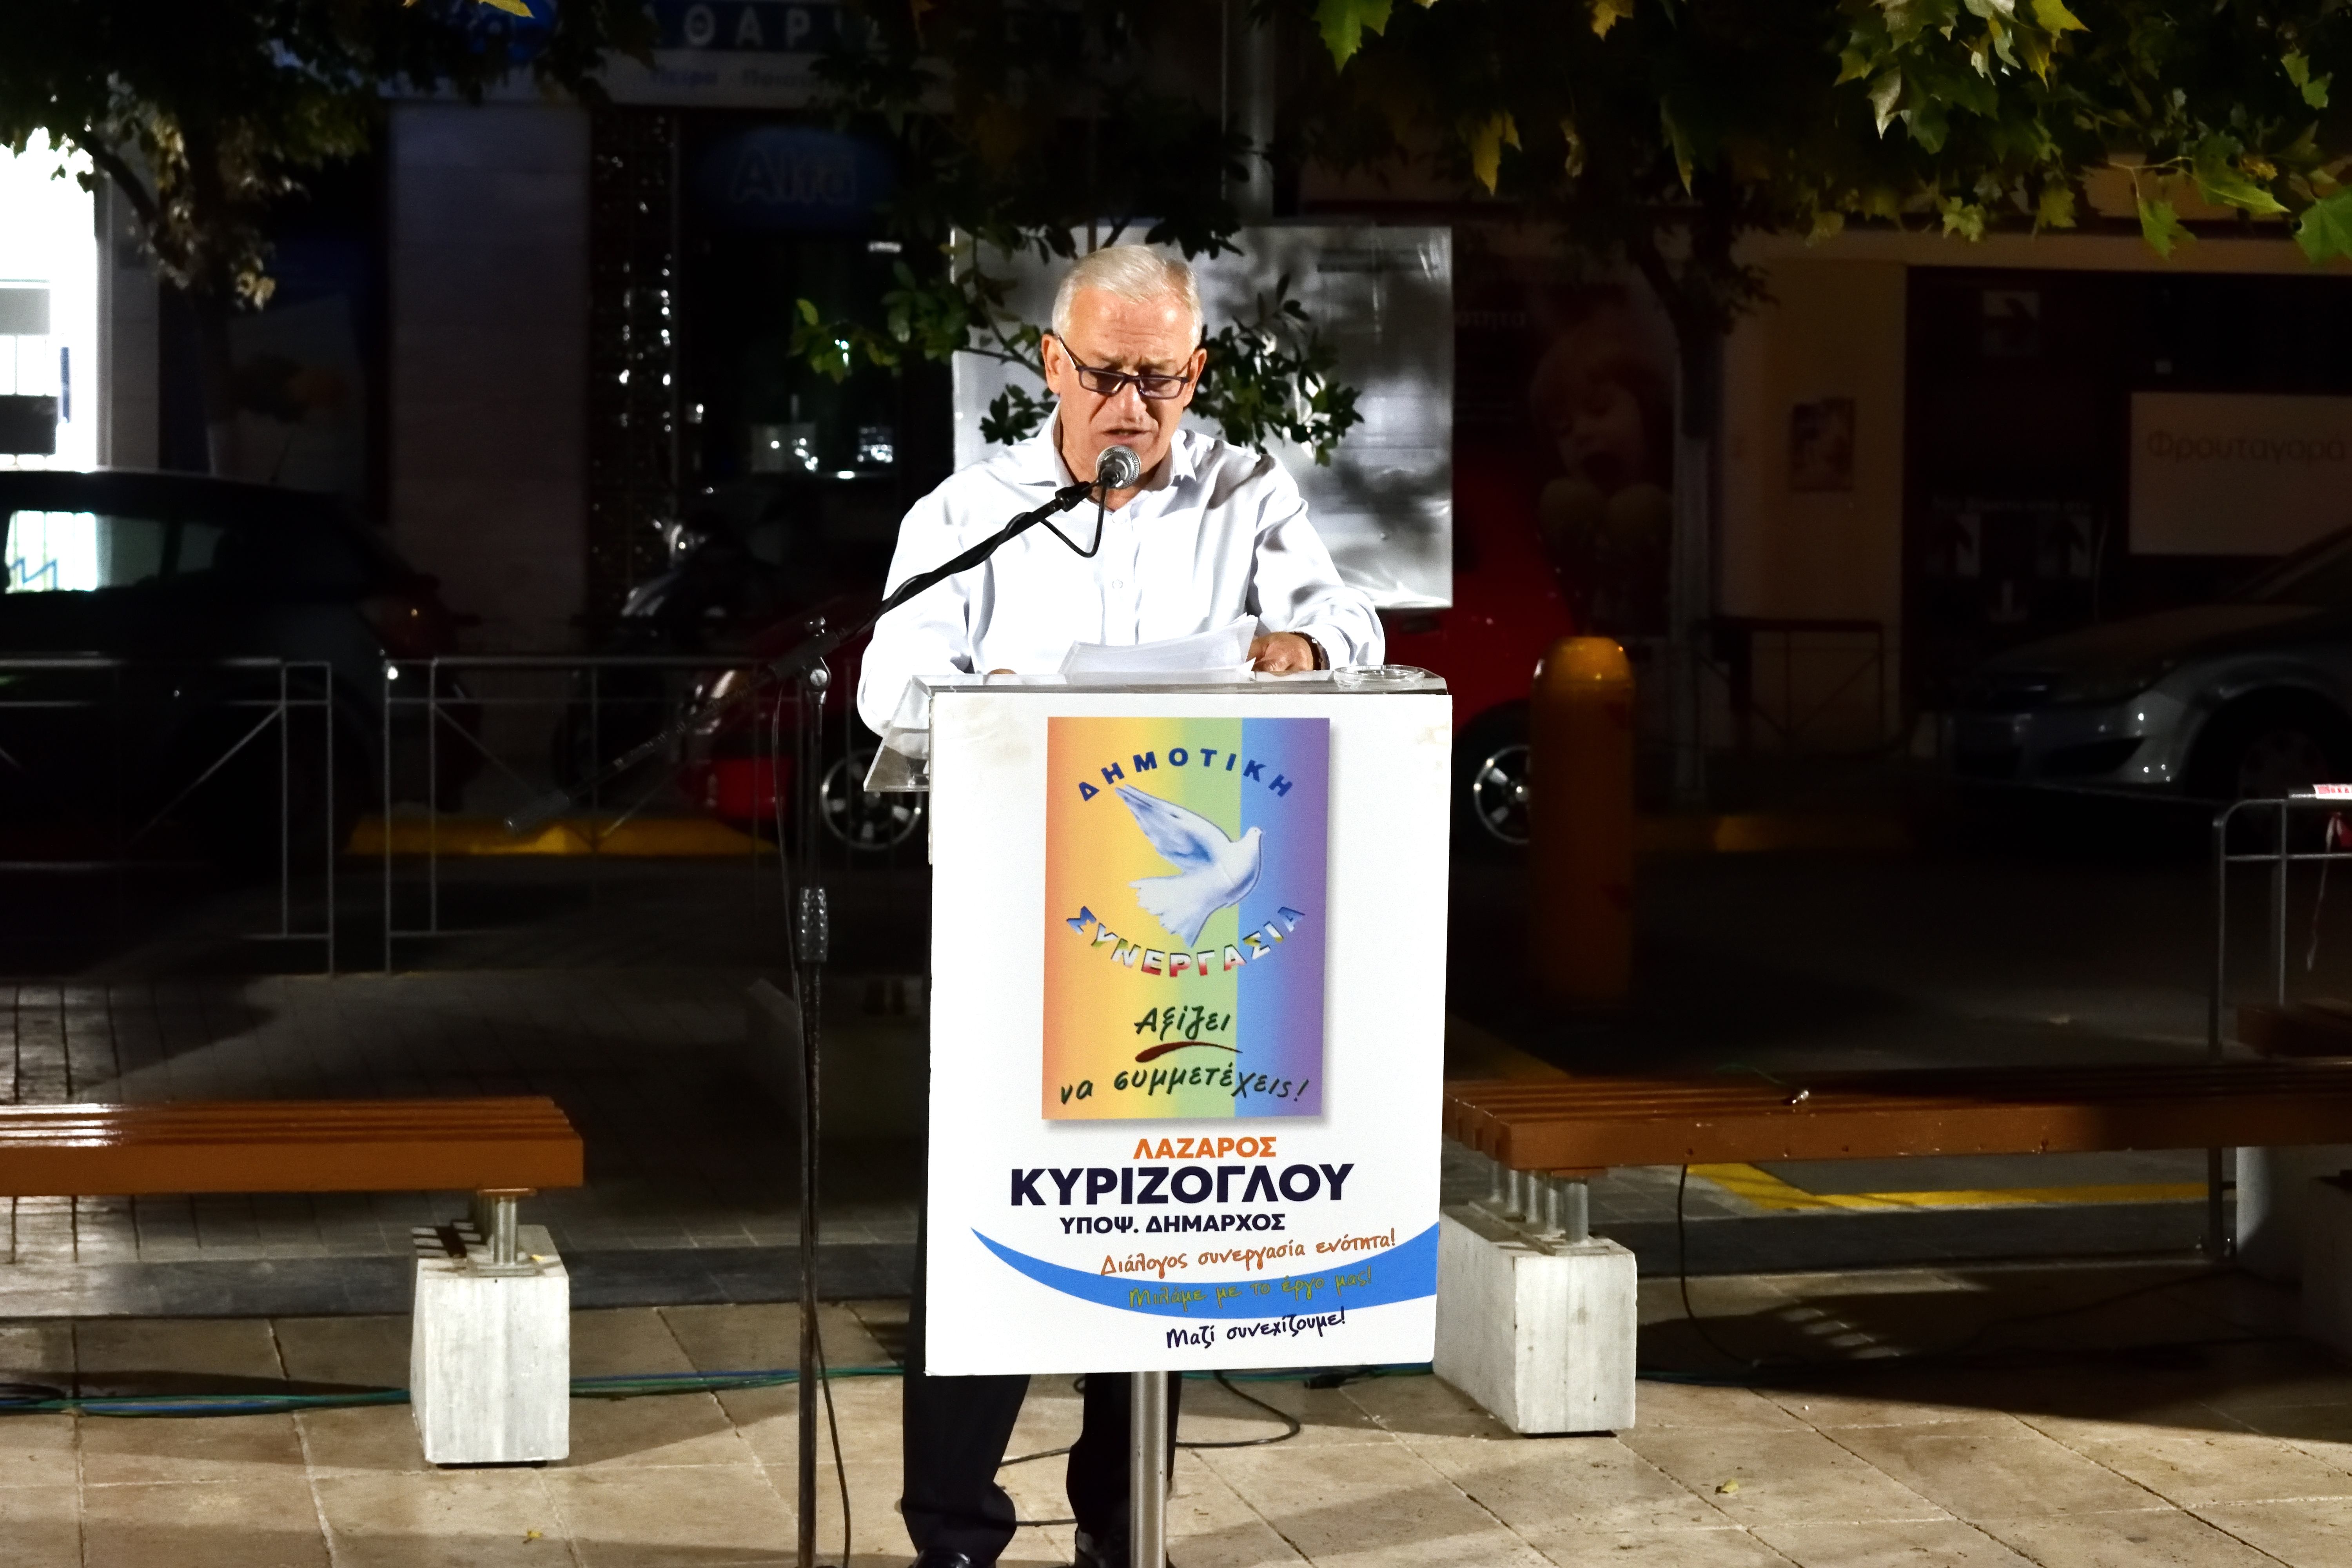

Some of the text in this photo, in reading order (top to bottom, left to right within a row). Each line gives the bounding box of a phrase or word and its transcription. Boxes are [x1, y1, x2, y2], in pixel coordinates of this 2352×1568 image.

[2147, 427, 2345, 466] Φρουταγορά
[1078, 747, 1293, 801] ΔΗΜΟΤΙΚΗ
[1065, 906, 1305, 977] ΣΥΝΕΡΓΑΣΙΑ
[1134, 1005, 1231, 1040] Αξίζει
[1060, 1063, 1309, 1104] να συμμετέχεις!
[1133, 1136, 1277, 1160] ΛΑΖΑΡΟΣ
[1011, 1163, 1354, 1206] ΚΥΡΙΖΟΓΛΟΥ
[1060, 1213, 1286, 1235] ΥΠΟΨ. ΔΗΜΑΡΧΟΣ
[1101, 1228, 1396, 1279] Διάλογος συνεργασία ενότητα!
[1129, 1266, 1372, 1312] Μιλάμε με το έργο μας!
[1166, 1307, 1345, 1348] Μαζί συνεχίζουμε!
